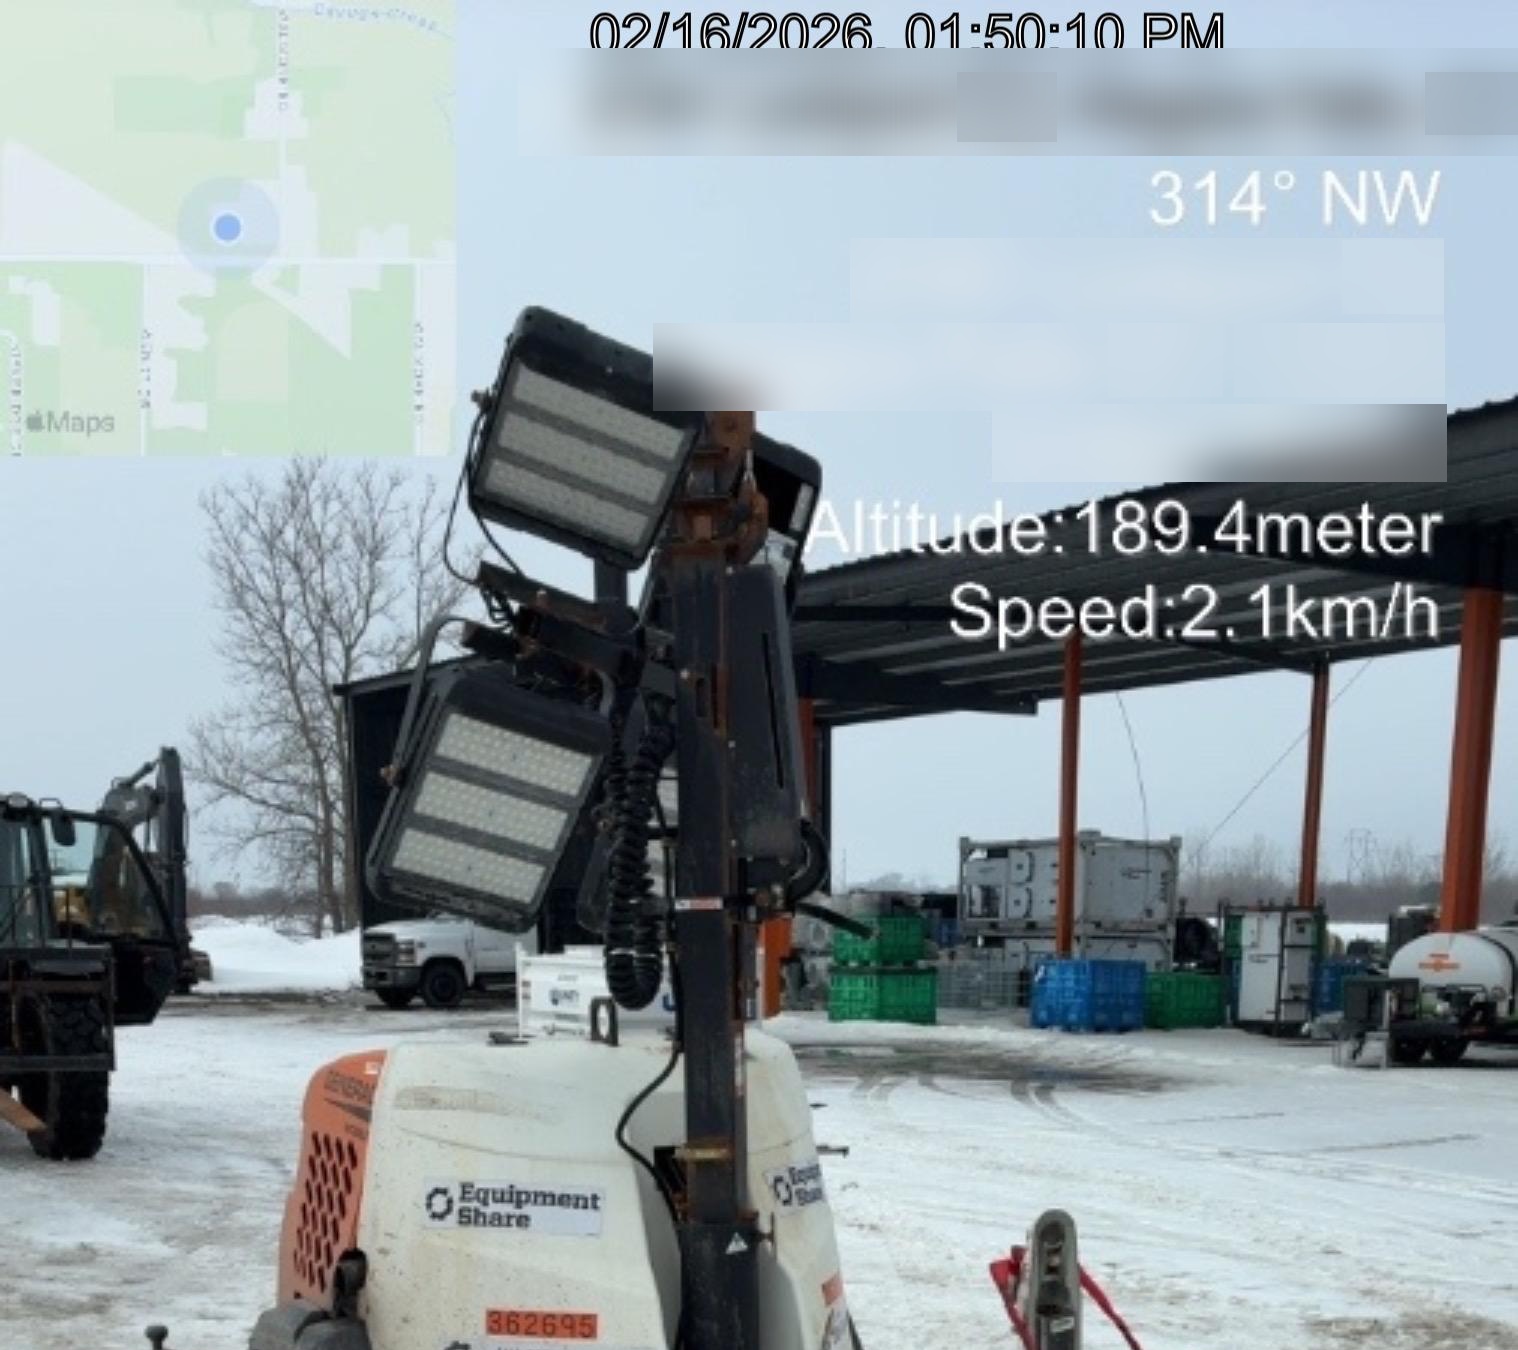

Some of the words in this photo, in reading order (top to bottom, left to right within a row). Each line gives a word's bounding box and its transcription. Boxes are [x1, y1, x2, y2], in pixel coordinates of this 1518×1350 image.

[460, 1182, 600, 1210] Equipment
[458, 1206, 530, 1228] Share
[487, 1310, 595, 1338] 362695
